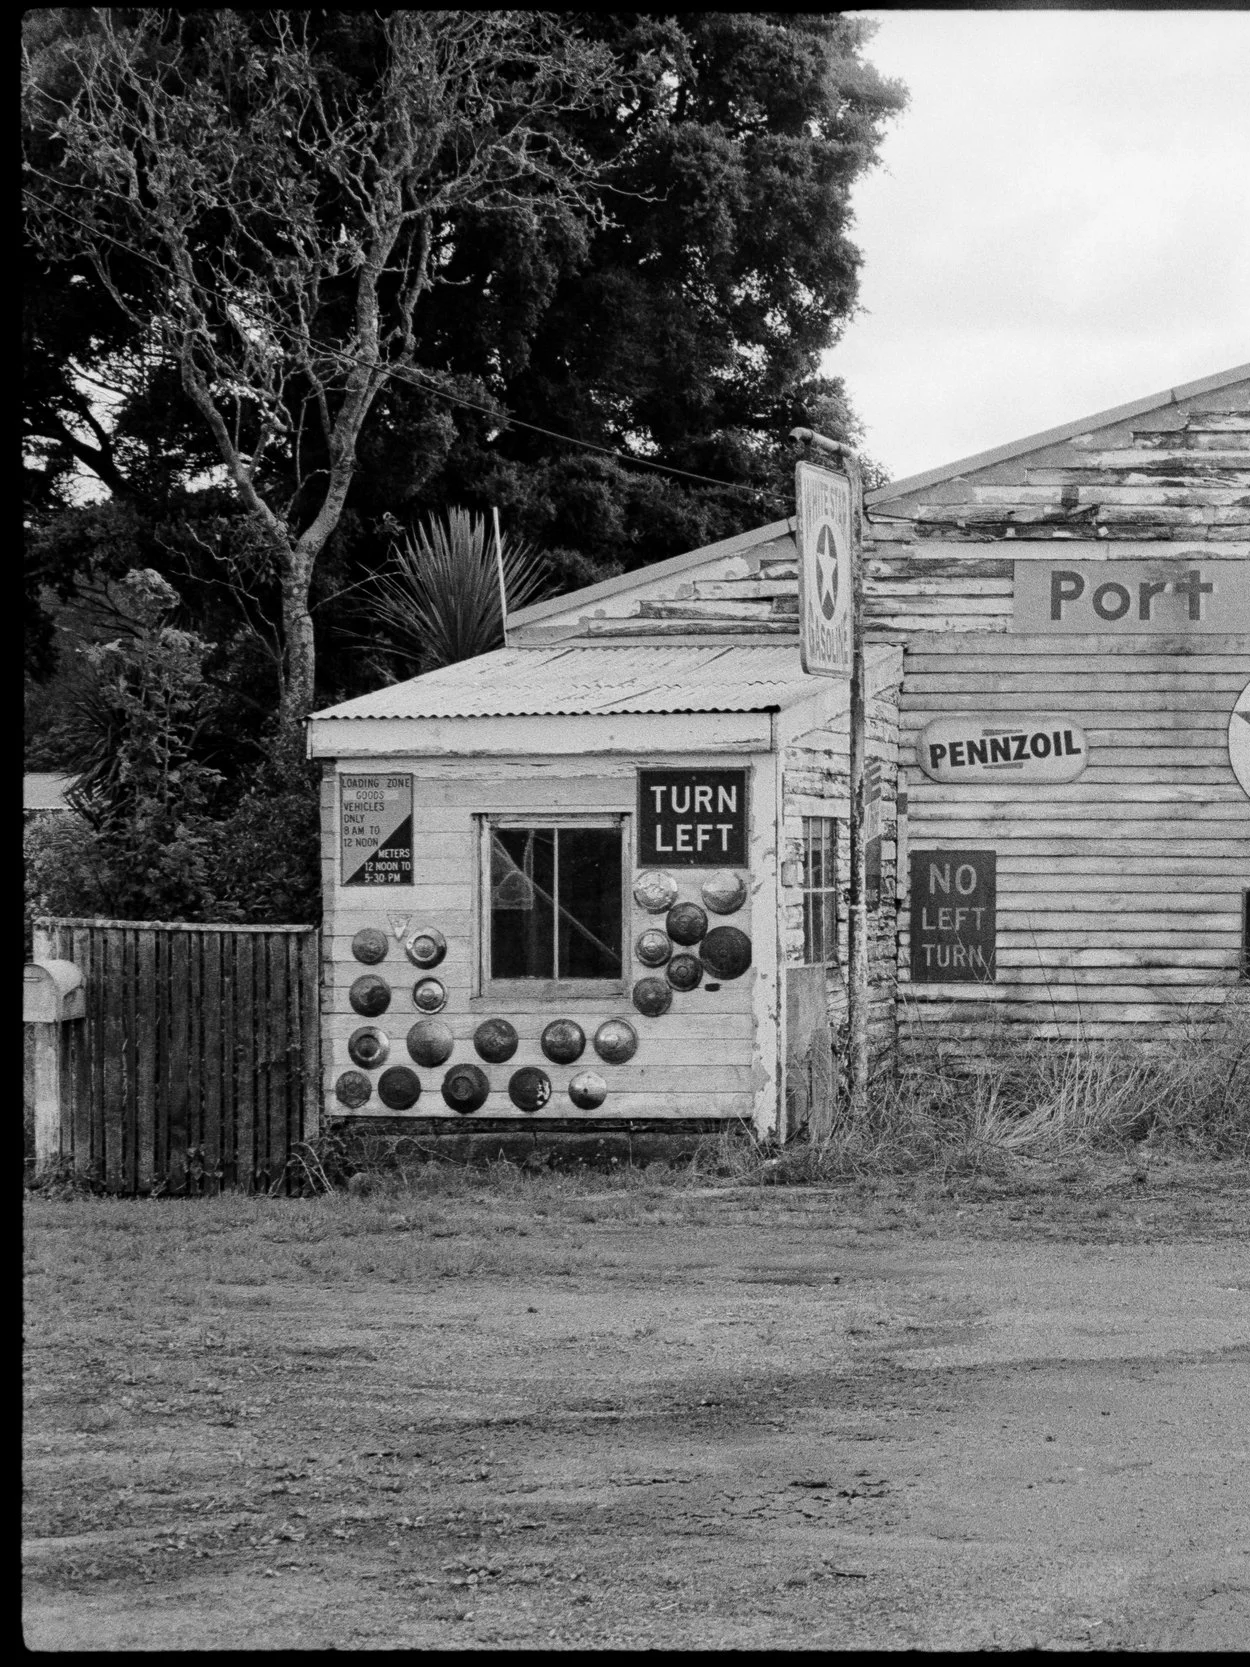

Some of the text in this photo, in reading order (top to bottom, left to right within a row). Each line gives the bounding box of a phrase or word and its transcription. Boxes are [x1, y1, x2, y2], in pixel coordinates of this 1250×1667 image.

[1050, 569, 1213, 621] Port
[929, 730, 1082, 769] PENNZOIL
[341, 778, 411, 788] LOADING ZONE
[356, 790, 385, 800] GOODS
[650, 785, 737, 813] TURN
[343, 802, 385, 812] VEHICLES
[343, 814, 365, 824] ONLY
[343, 826, 380, 836] 8 AM TO
[343, 838, 379, 847] 12 NOON
[656, 824, 733, 851] LEFT
[378, 848, 411, 858] METERS
[365, 861, 411, 871] 12 NOON TO
[388, 873, 401, 883] PM
[929, 863, 977, 895] NO
[922, 907, 985, 930] LEFT
[922, 944, 982, 967] TURN
